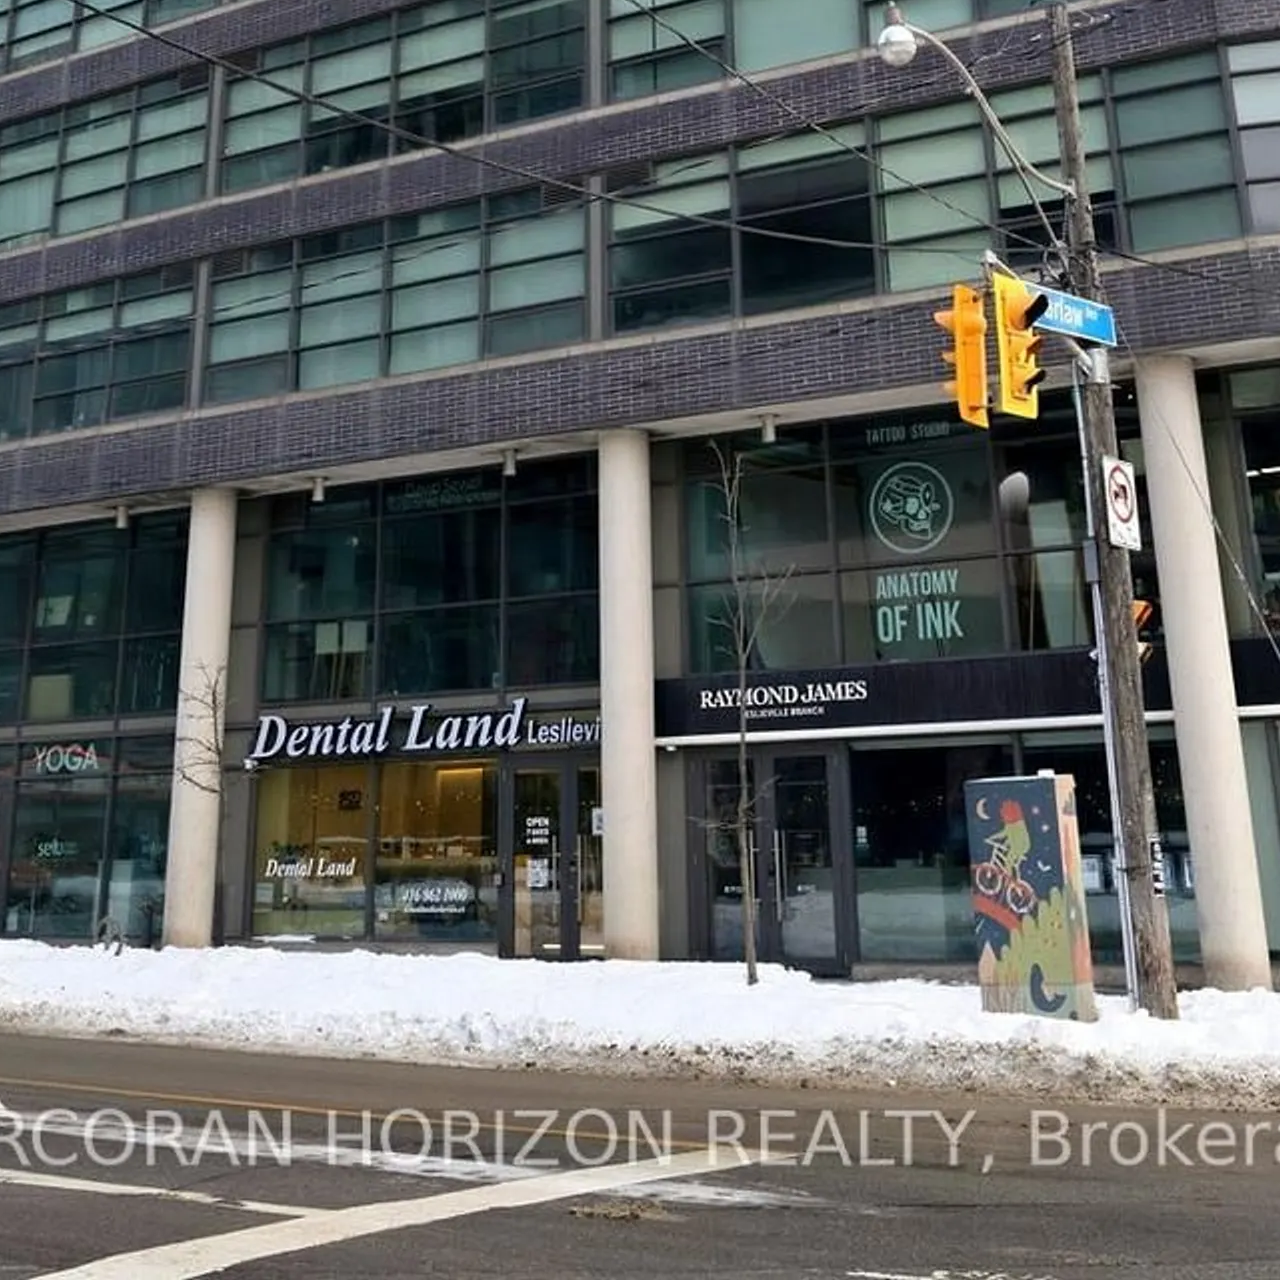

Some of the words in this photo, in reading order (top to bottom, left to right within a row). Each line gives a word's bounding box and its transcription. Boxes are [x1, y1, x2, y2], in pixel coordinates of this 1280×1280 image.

[1044, 297, 1084, 328] arlaw
[866, 425, 906, 445] TATTOO
[876, 568, 959, 601] ANATOMY
[877, 604, 908, 644] OF
[916, 599, 964, 640] INK
[700, 684, 800, 709] RAYMOND
[801, 680, 868, 704] JAMES
[250, 706, 394, 759] Dental
[401, 696, 526, 751] Land
[526, 715, 602, 745] Leslievi
[743, 707, 788, 719] ESLIEVILLE
[33, 742, 100, 773] YOGA
[526, 816, 550, 827] OPEN
[264, 857, 314, 880] Dental
[317, 856, 356, 878] Land
